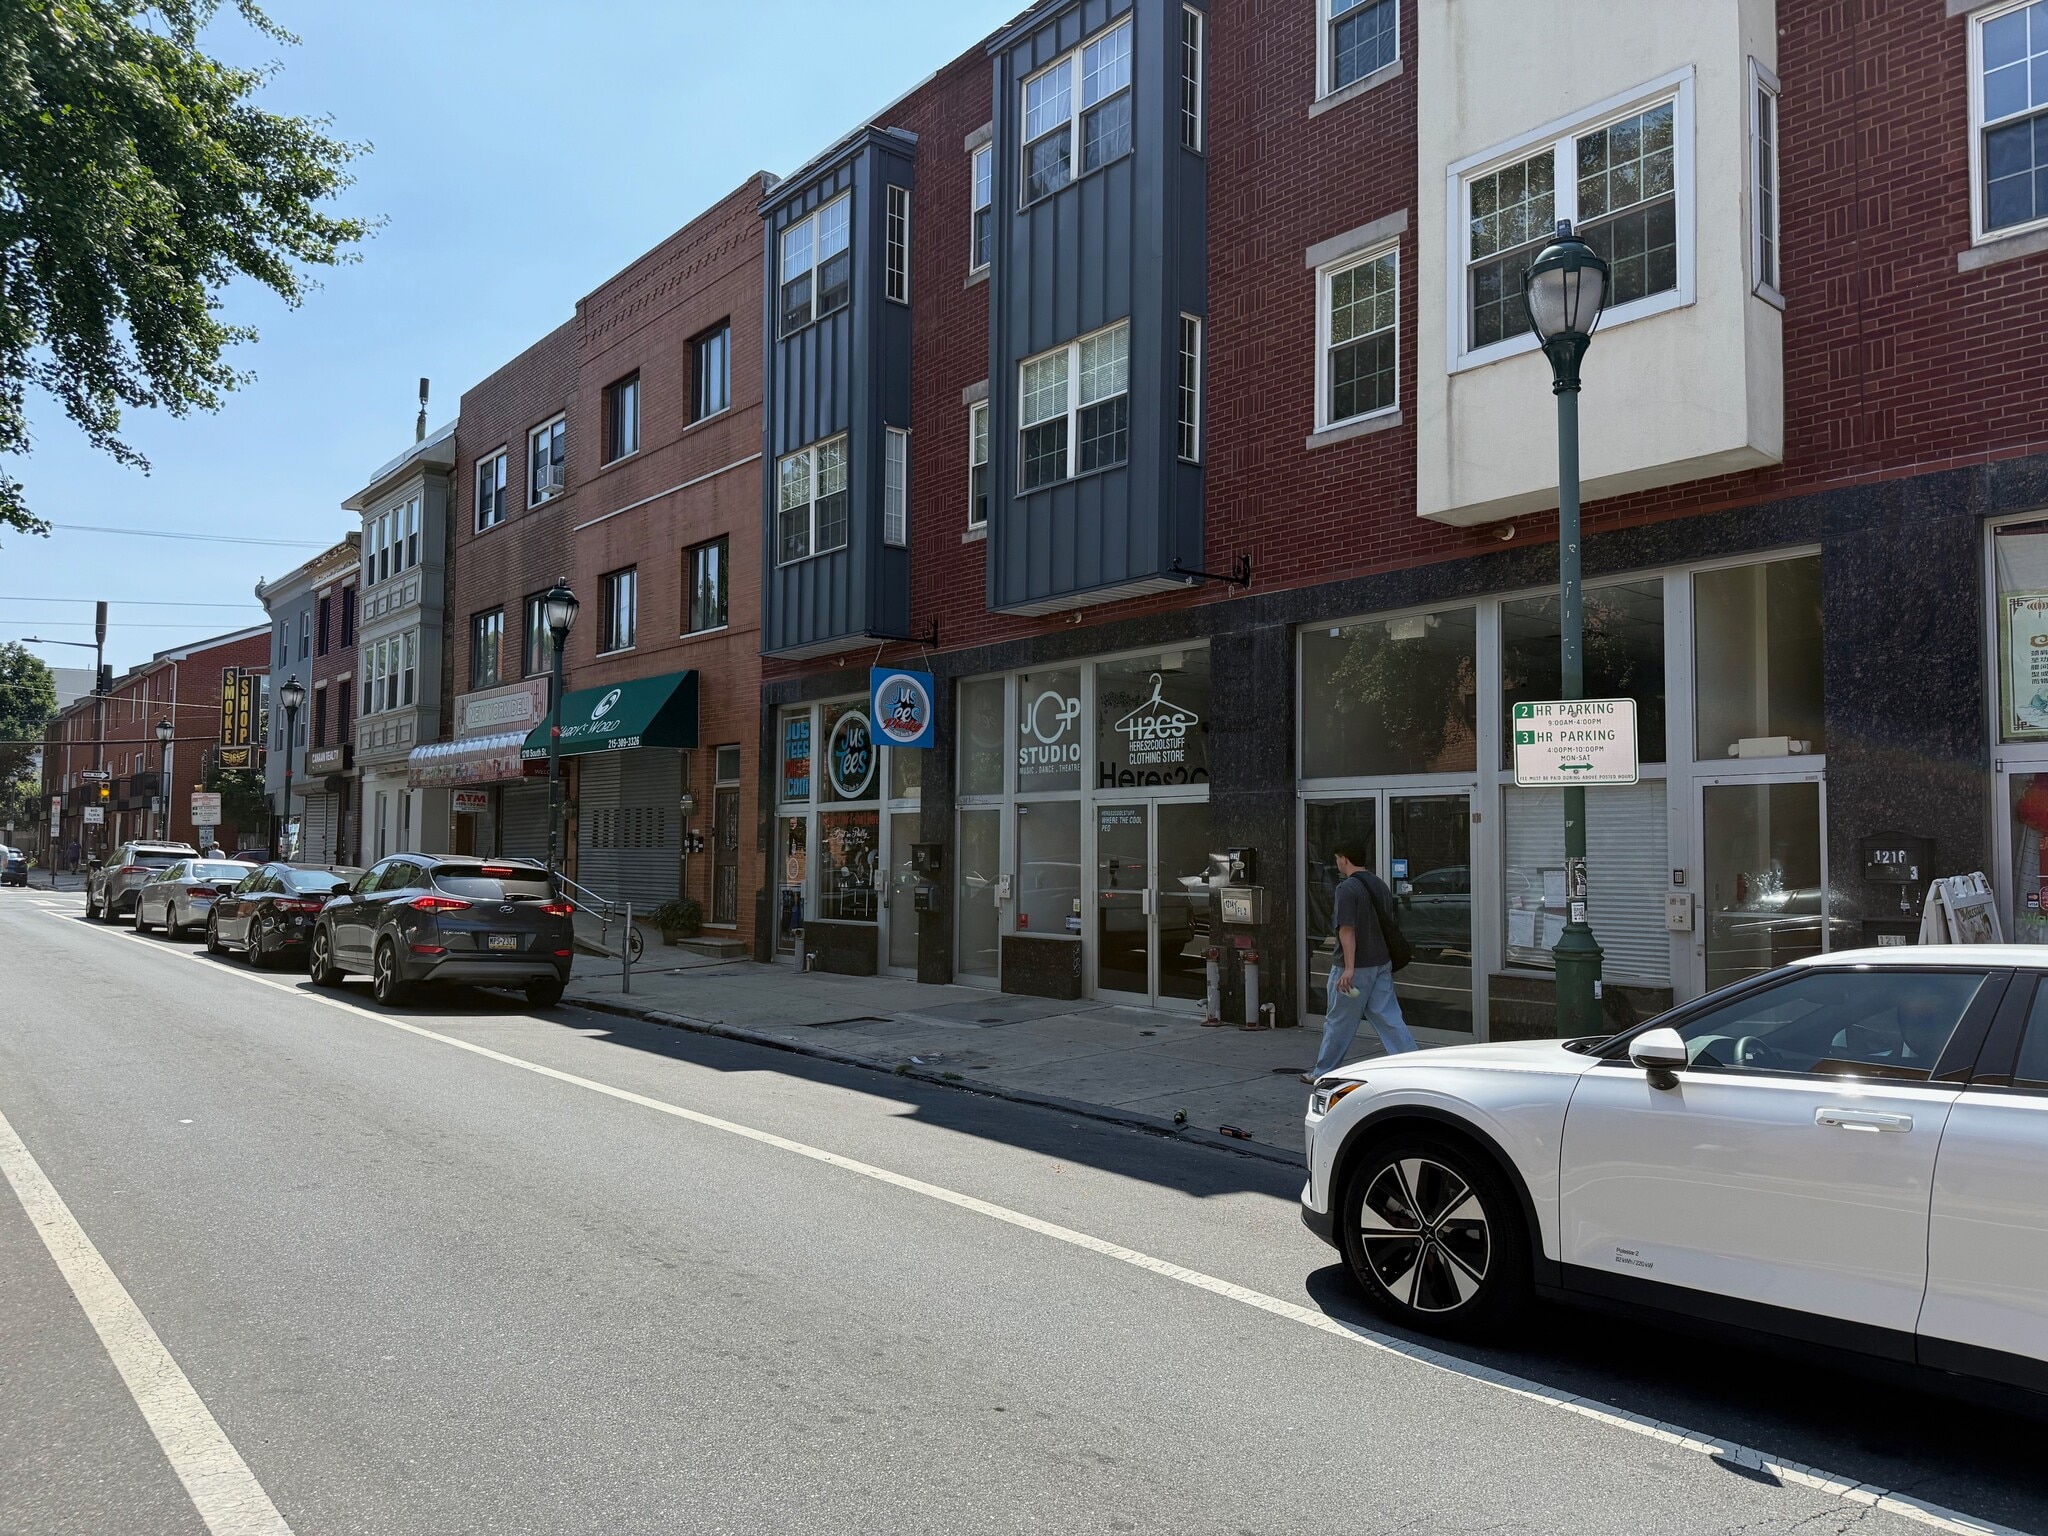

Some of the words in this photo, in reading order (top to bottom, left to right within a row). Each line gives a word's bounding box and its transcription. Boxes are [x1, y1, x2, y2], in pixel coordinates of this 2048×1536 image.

[891, 684, 916, 704] Jus
[224, 670, 234, 744] SMOKE
[240, 680, 249, 743] SHOP
[468, 706, 488, 724] NEW
[488, 701, 510, 720] YORK
[510, 696, 529, 716] DELI
[1521, 706, 1528, 717] 2
[1536, 706, 1552, 716] HR
[1560, 703, 1614, 715] PARKING
[588, 720, 620, 733] WORLD
[786, 721, 809, 740] JUS
[1130, 714, 1186, 740] H2CS
[608, 736, 640, 748] 215-309-3326
[842, 724, 864, 751] Jus
[1129, 738, 1185, 752] HERES2COOLSTUFF
[1522, 732, 1529, 743] 3
[1537, 732, 1553, 742] HR
[1560, 730, 1615, 742] PARKING
[530, 748, 541, 757] South
[786, 740, 809, 759] TEES
[1020, 743, 1080, 765] STUDIO
[1129, 751, 1161, 765] CLOTHING
[1163, 750, 1185, 763] STORE
[836, 748, 867, 781] Tees
[1039, 765, 1054, 774] DANCE
[1059, 764, 1080, 772] THEATRE
[456, 794, 486, 803] ATM
